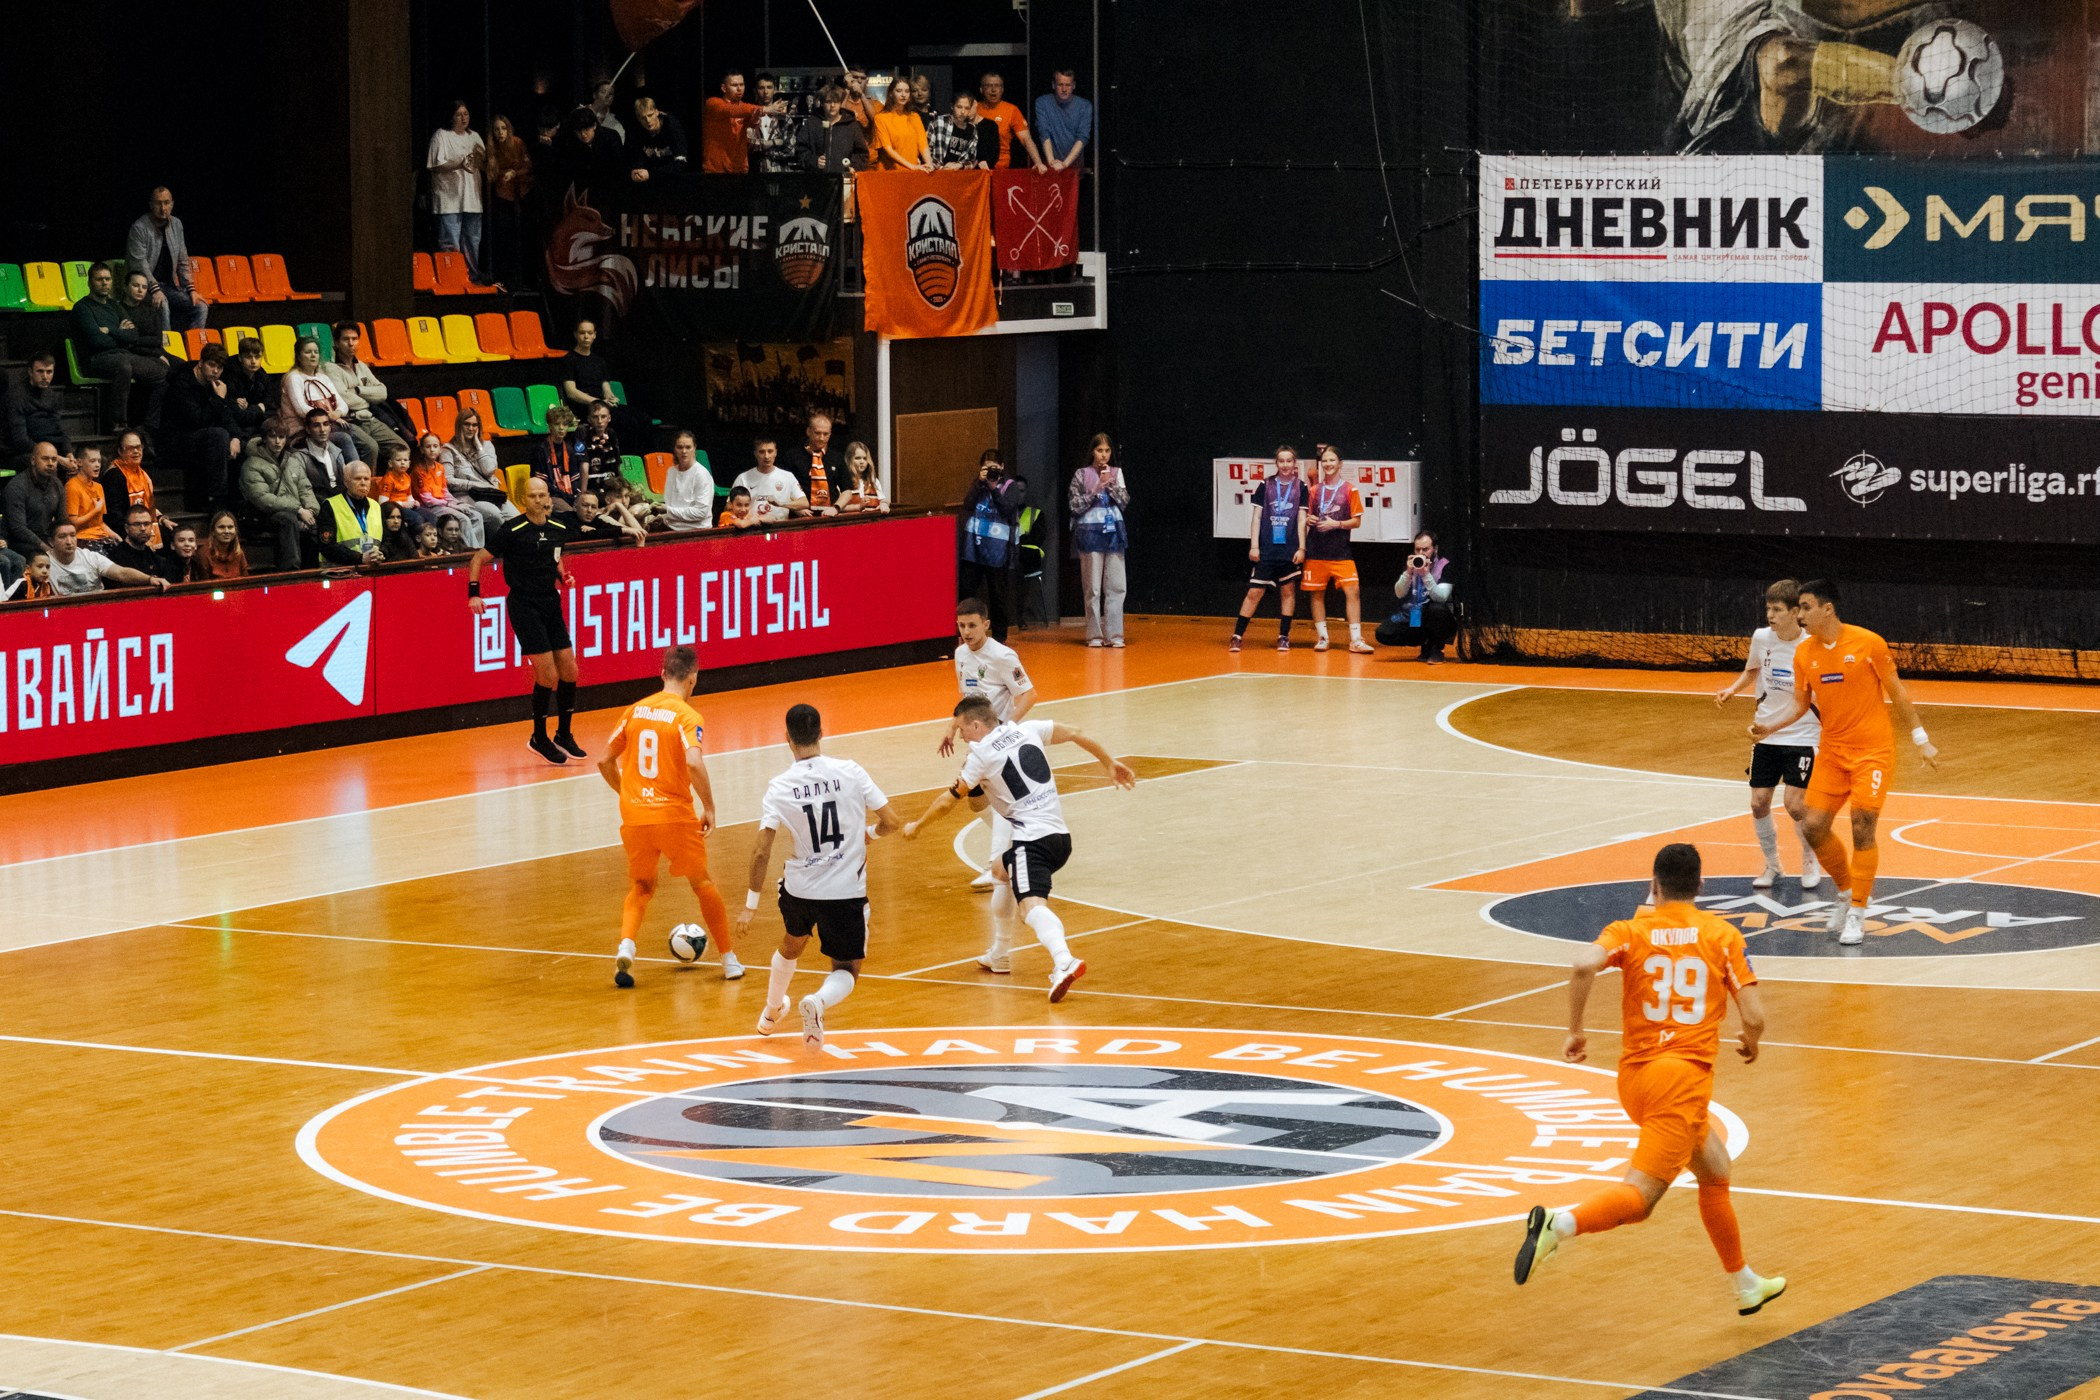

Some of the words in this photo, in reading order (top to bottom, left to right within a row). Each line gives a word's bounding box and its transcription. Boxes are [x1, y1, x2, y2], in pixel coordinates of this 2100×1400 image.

[1519, 176, 1662, 190] ПЕТЕРБУРГСКИЙ
[621, 213, 769, 250] НЕВСКИЕ
[1494, 197, 1810, 249] ДНЕВНИК
[1926, 194, 2100, 242] МЯ
[645, 253, 740, 290] ЛИСЫ
[1492, 319, 1809, 370] БЕТСИТИ
[1489, 428, 1807, 512] JÖGEL
[474, 560, 830, 672] @ISTALLFUTSAL
[638, 729, 659, 779] 8
[1001, 743, 1052, 801] 10
[1798, 756, 1812, 771] 47
[792, 779, 841, 800] САЛХИ
[1871, 769, 1883, 790] 9
[802, 800, 845, 854] 14
[1643, 955, 1708, 1016] 39
[456, 1048, 795, 1099] TRAIN
[822, 1038, 1183, 1060] HARD
[1208, 1043, 1383, 1069] BE
[393, 1104, 628, 1201] HUMBLE
[597, 1193, 803, 1227] BE
[1281, 1155, 1631, 1220] TRAIN
[829, 1204, 1273, 1236] HARD
